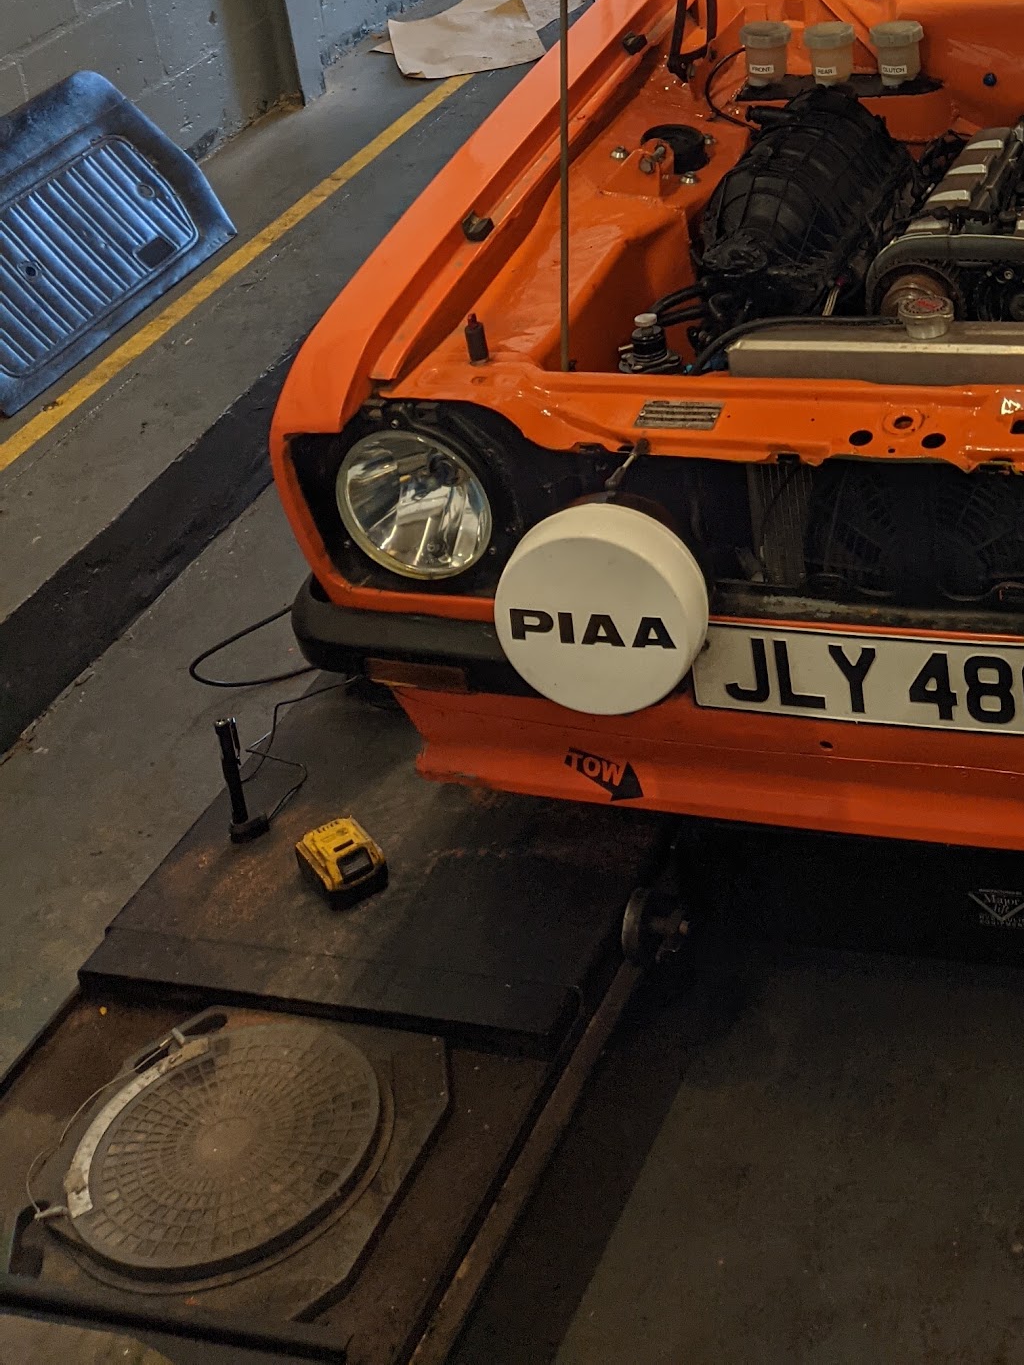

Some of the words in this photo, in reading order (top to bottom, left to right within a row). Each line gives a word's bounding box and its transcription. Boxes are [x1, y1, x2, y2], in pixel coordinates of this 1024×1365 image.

[751, 65, 771, 73] FRONT
[509, 608, 677, 650] PIAA
[725, 637, 876, 714] JLY
[565, 750, 622, 787] TOW
[983, 894, 1020, 907] Major
